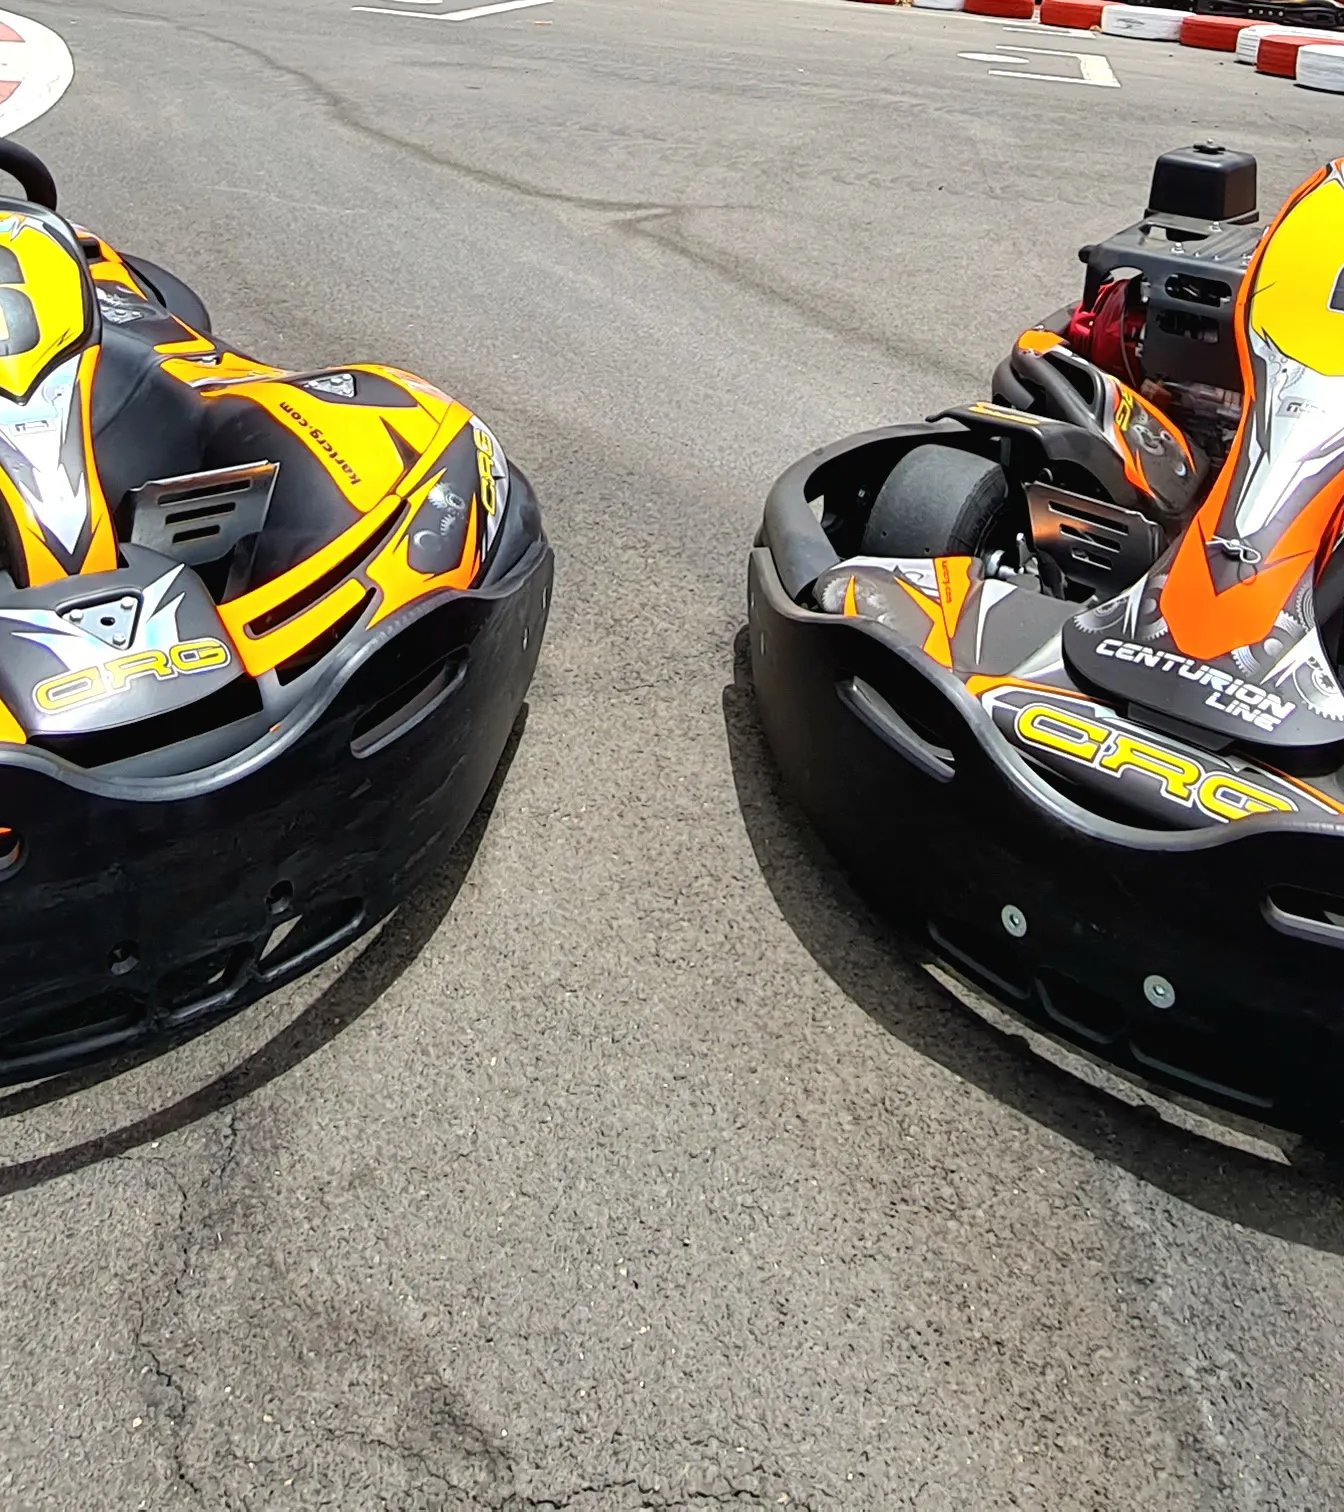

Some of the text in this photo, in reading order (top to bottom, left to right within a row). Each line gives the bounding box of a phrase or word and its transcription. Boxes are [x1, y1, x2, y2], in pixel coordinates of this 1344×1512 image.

[279, 401, 363, 486] kartcrg.com
[472, 428, 497, 517] CRG
[33, 638, 232, 714] CRG
[1014, 701, 1299, 823] CRG
